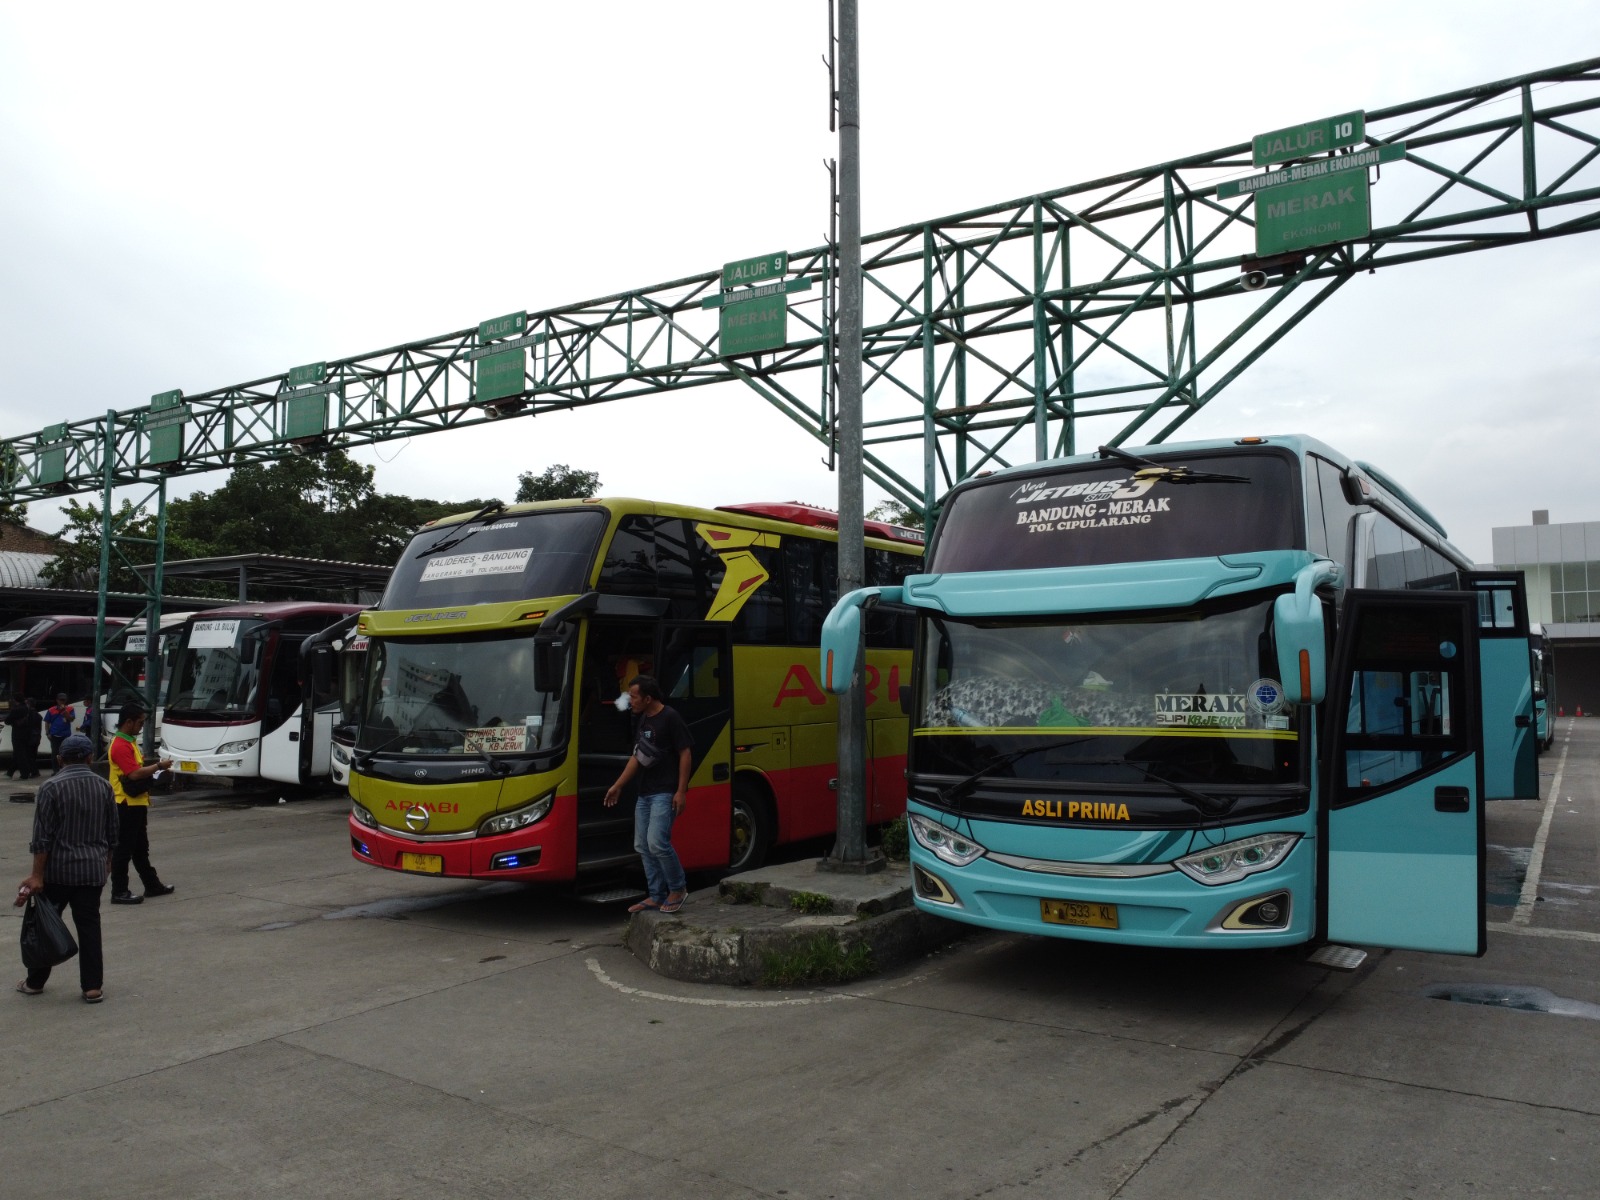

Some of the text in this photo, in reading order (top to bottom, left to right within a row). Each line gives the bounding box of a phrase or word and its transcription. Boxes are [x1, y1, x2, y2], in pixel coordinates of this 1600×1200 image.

[1261, 121, 1353, 158] JALUR 10
[1239, 149, 1380, 192] BANDUNG-MERAK EKONOMI
[1267, 186, 1356, 219] MERAK
[1283, 221, 1341, 241] EKONOMI
[728, 257, 782, 282] JALUR 9
[484, 317, 522, 336] JALUR 8
[728, 308, 778, 328] MERAK
[1009, 481, 1047, 499] New
[1016, 503, 1097, 525] BANDUNG
[1107, 497, 1171, 516] MERAK
[1029, 514, 1152, 533] TOL CIPULARANG
[428, 555, 475, 568] KALIDERES
[481, 550, 528, 562] BANDUNG
[1156, 695, 1246, 713] MERAK
[1156, 714, 1186, 723] SLIPI
[461, 767, 486, 775] HINO
[385, 800, 459, 814] ARIMBI
[1021, 799, 1131, 821] ASLI PRIMA
[1044, 901, 1114, 921] A 7533 KL
